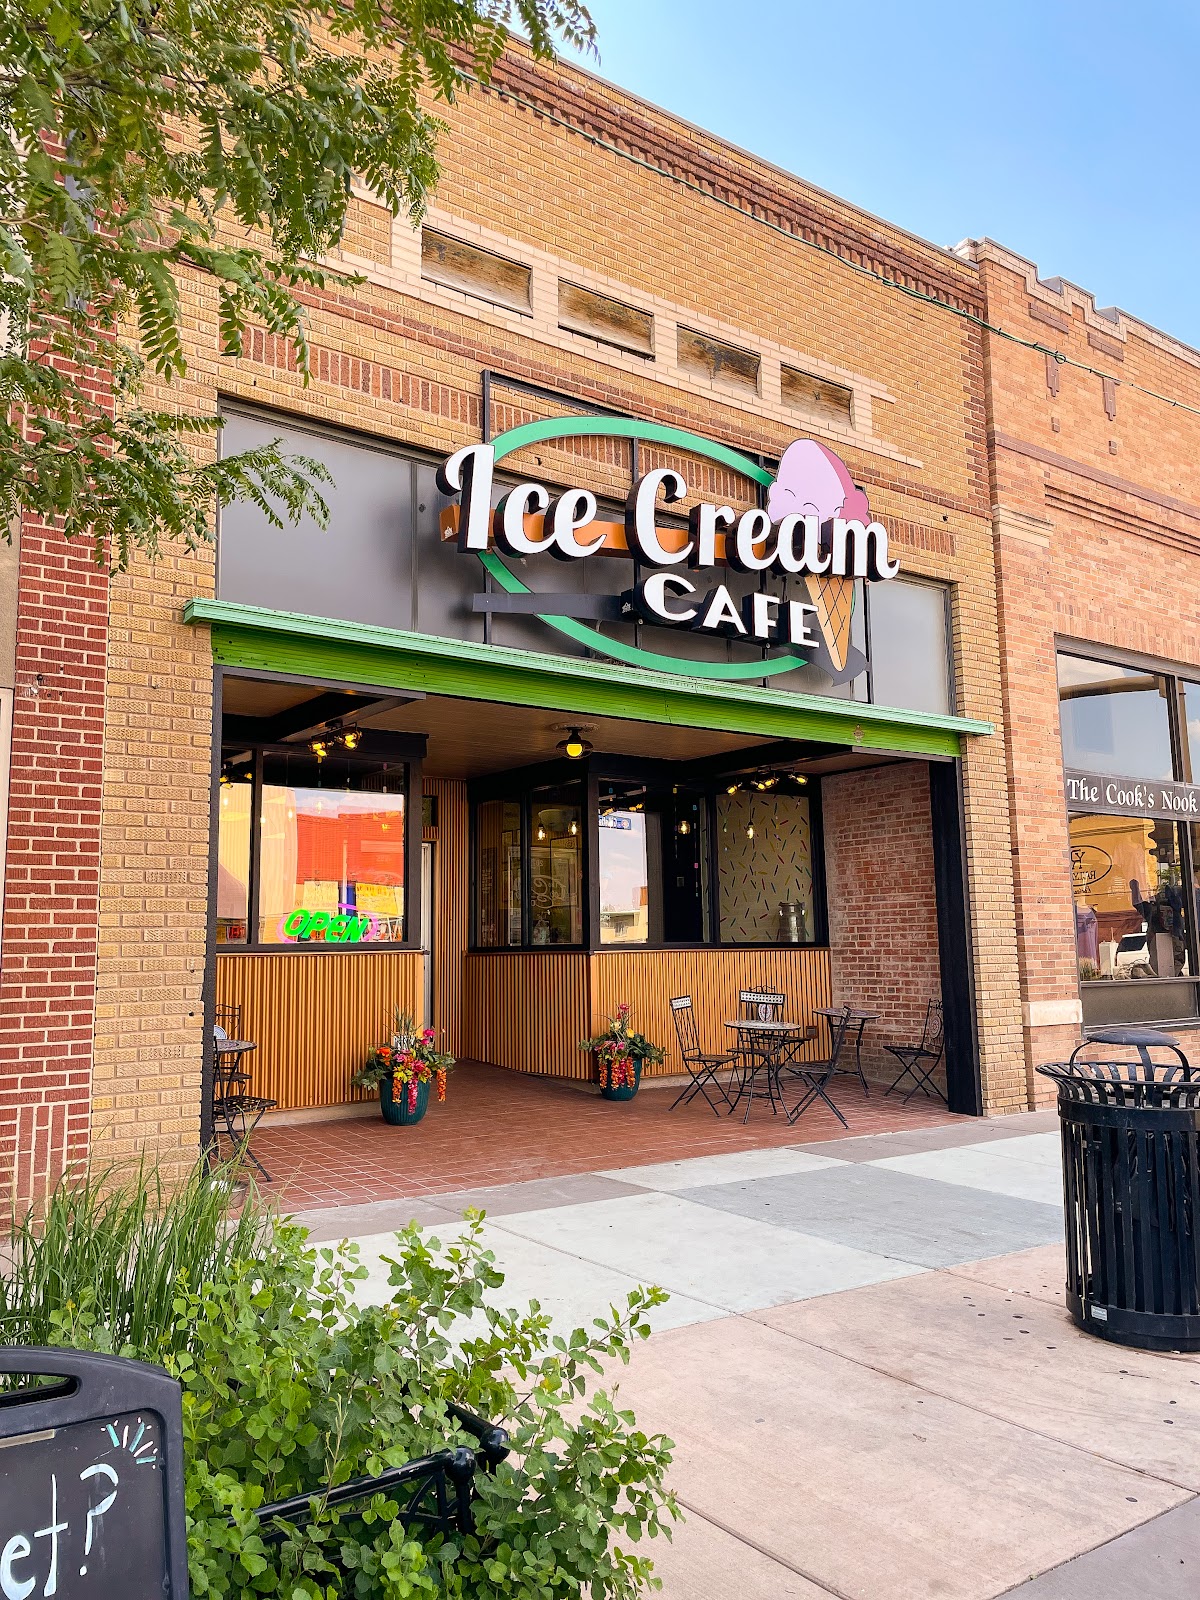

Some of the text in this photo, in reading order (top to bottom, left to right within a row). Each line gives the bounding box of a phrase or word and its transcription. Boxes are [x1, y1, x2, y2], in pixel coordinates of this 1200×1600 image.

[441, 444, 900, 580] Ice Cream
[643, 572, 821, 648] CAFE
[1067, 777, 1198, 812] The Cook's Nook
[284, 909, 369, 943] OPEN
